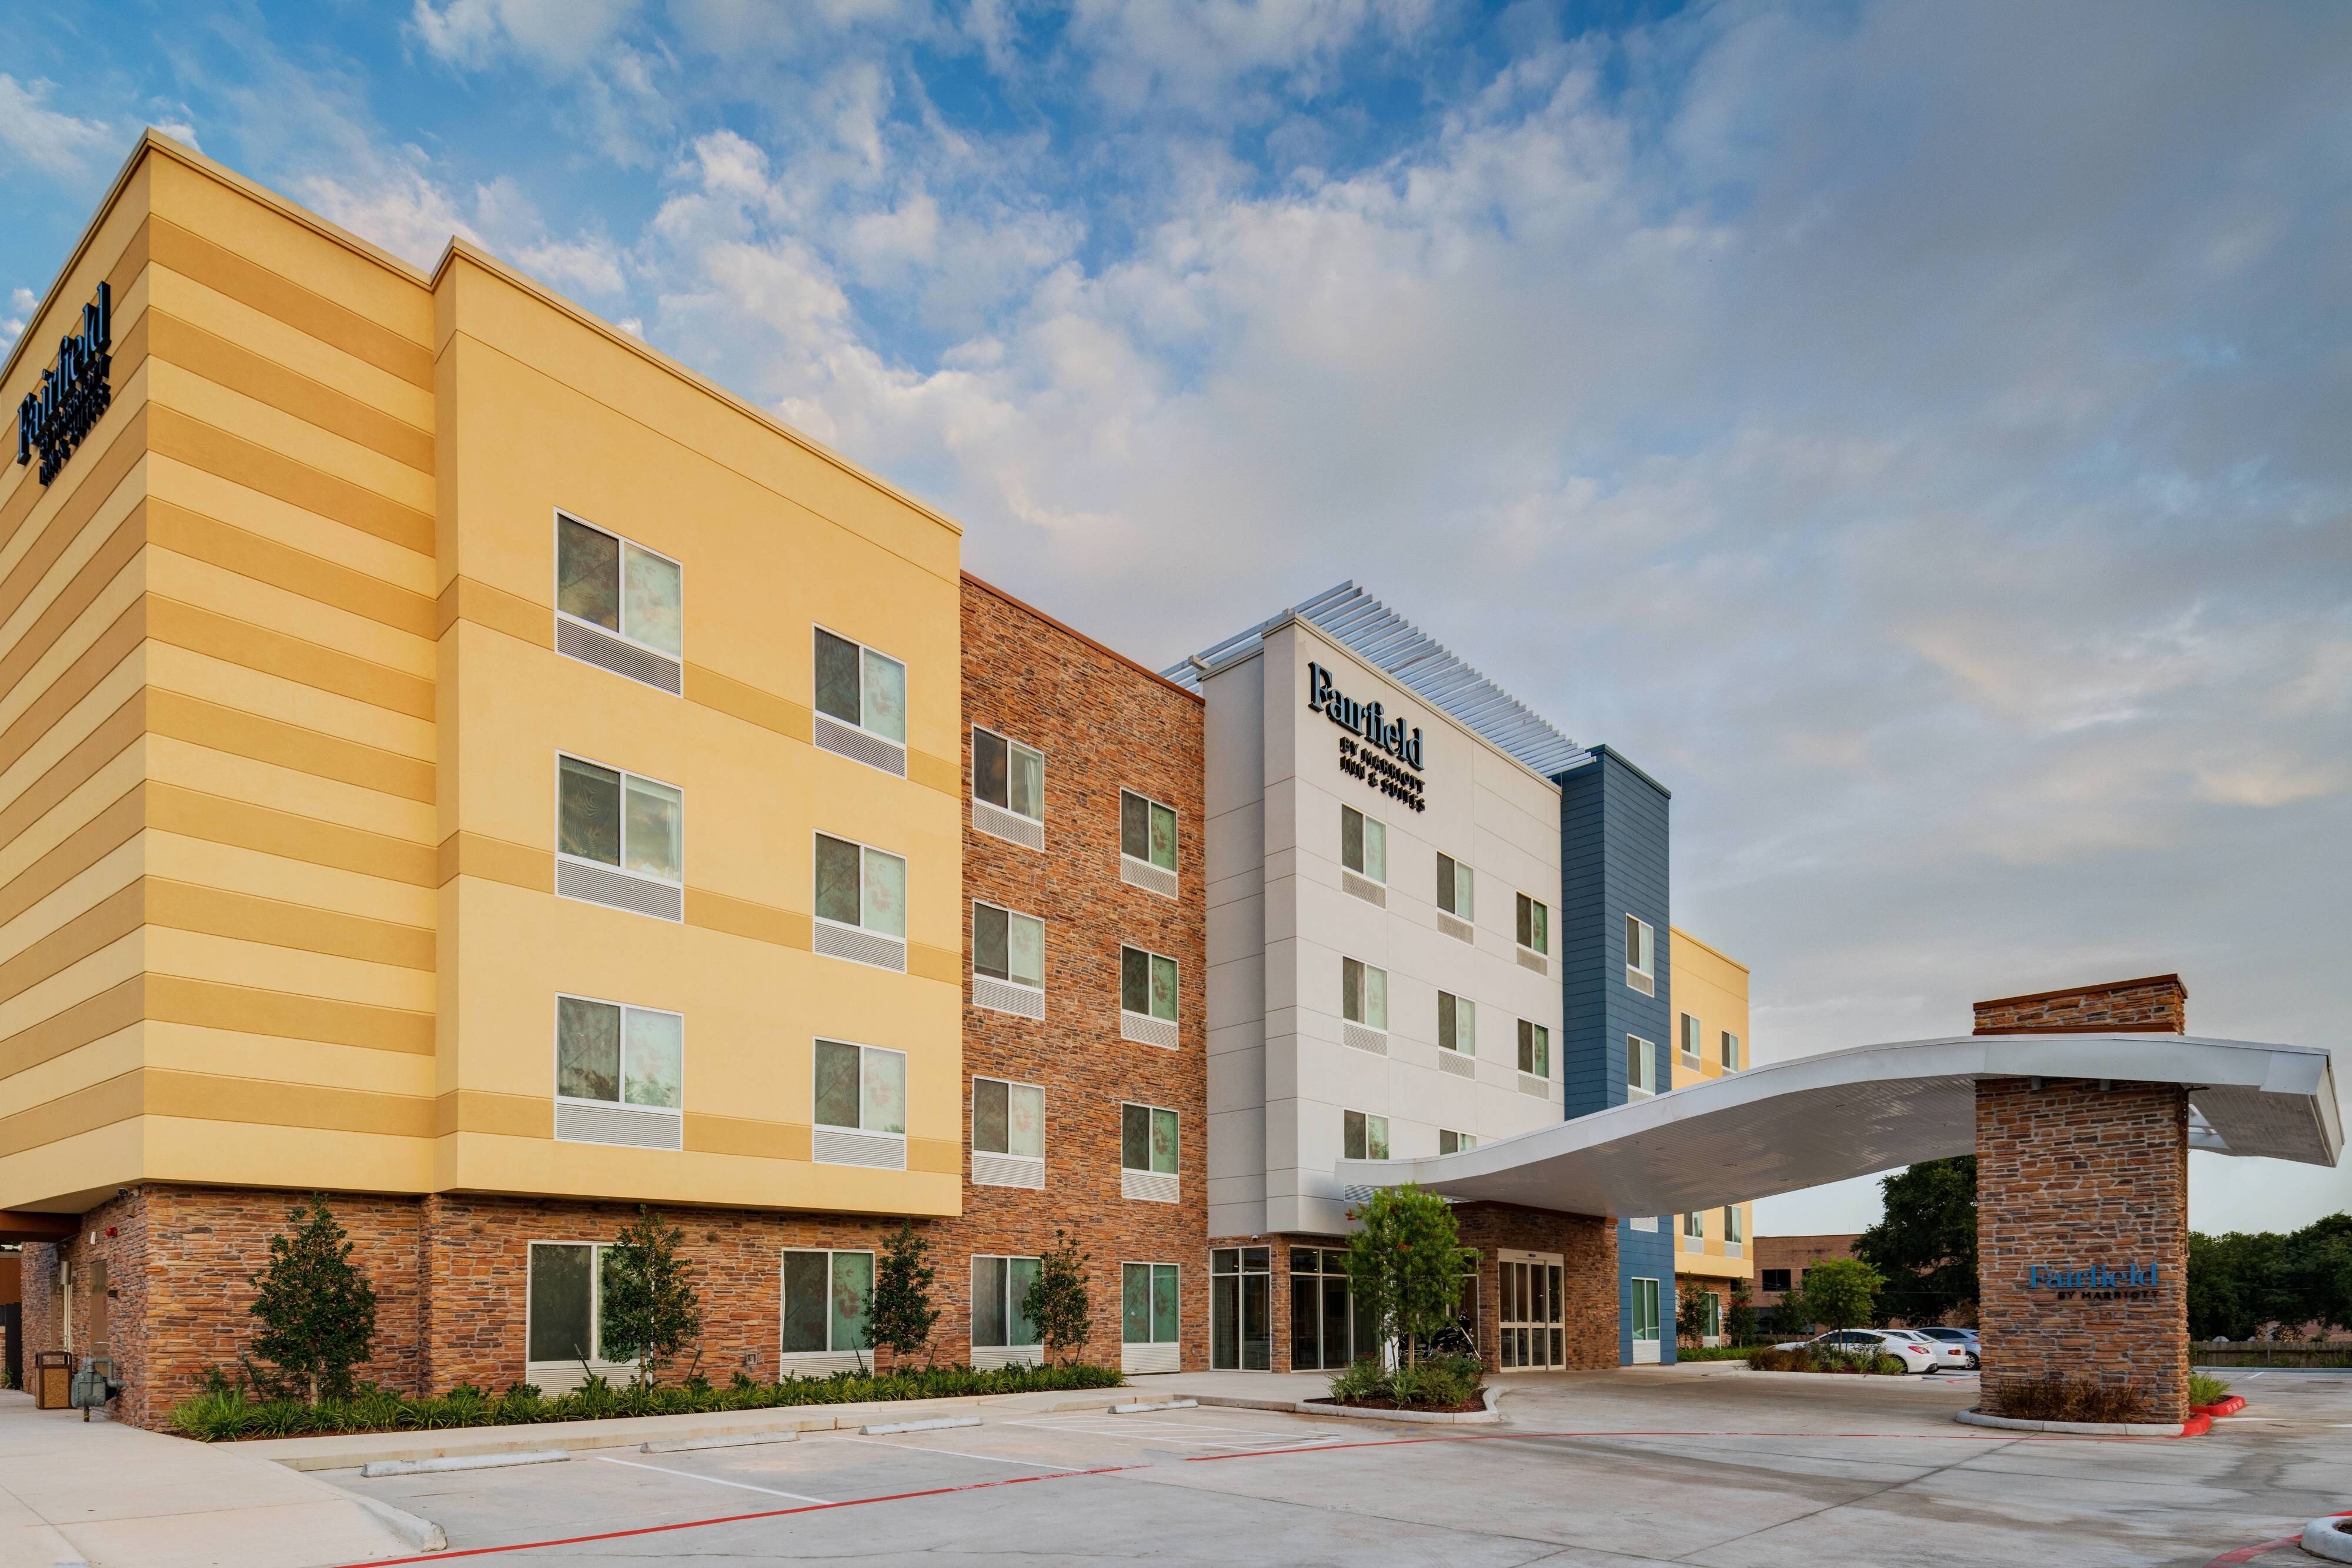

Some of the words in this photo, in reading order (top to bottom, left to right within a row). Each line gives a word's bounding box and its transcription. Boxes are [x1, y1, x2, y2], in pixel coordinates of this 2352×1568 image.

[17, 280, 112, 466] Fairfield
[1308, 661, 1424, 771] Fairfield
[1339, 736, 1359, 757] BY
[1360, 748, 1425, 794] MARRIOTT
[1340, 755, 1366, 781] INN
[1368, 771, 1378, 787] &
[1380, 777, 1425, 813] SUITES
[2029, 1262, 2158, 1289] Fairfield
[2058, 1290, 2076, 1300] BY
[2082, 1290, 2160, 1300] MARRIOTT
